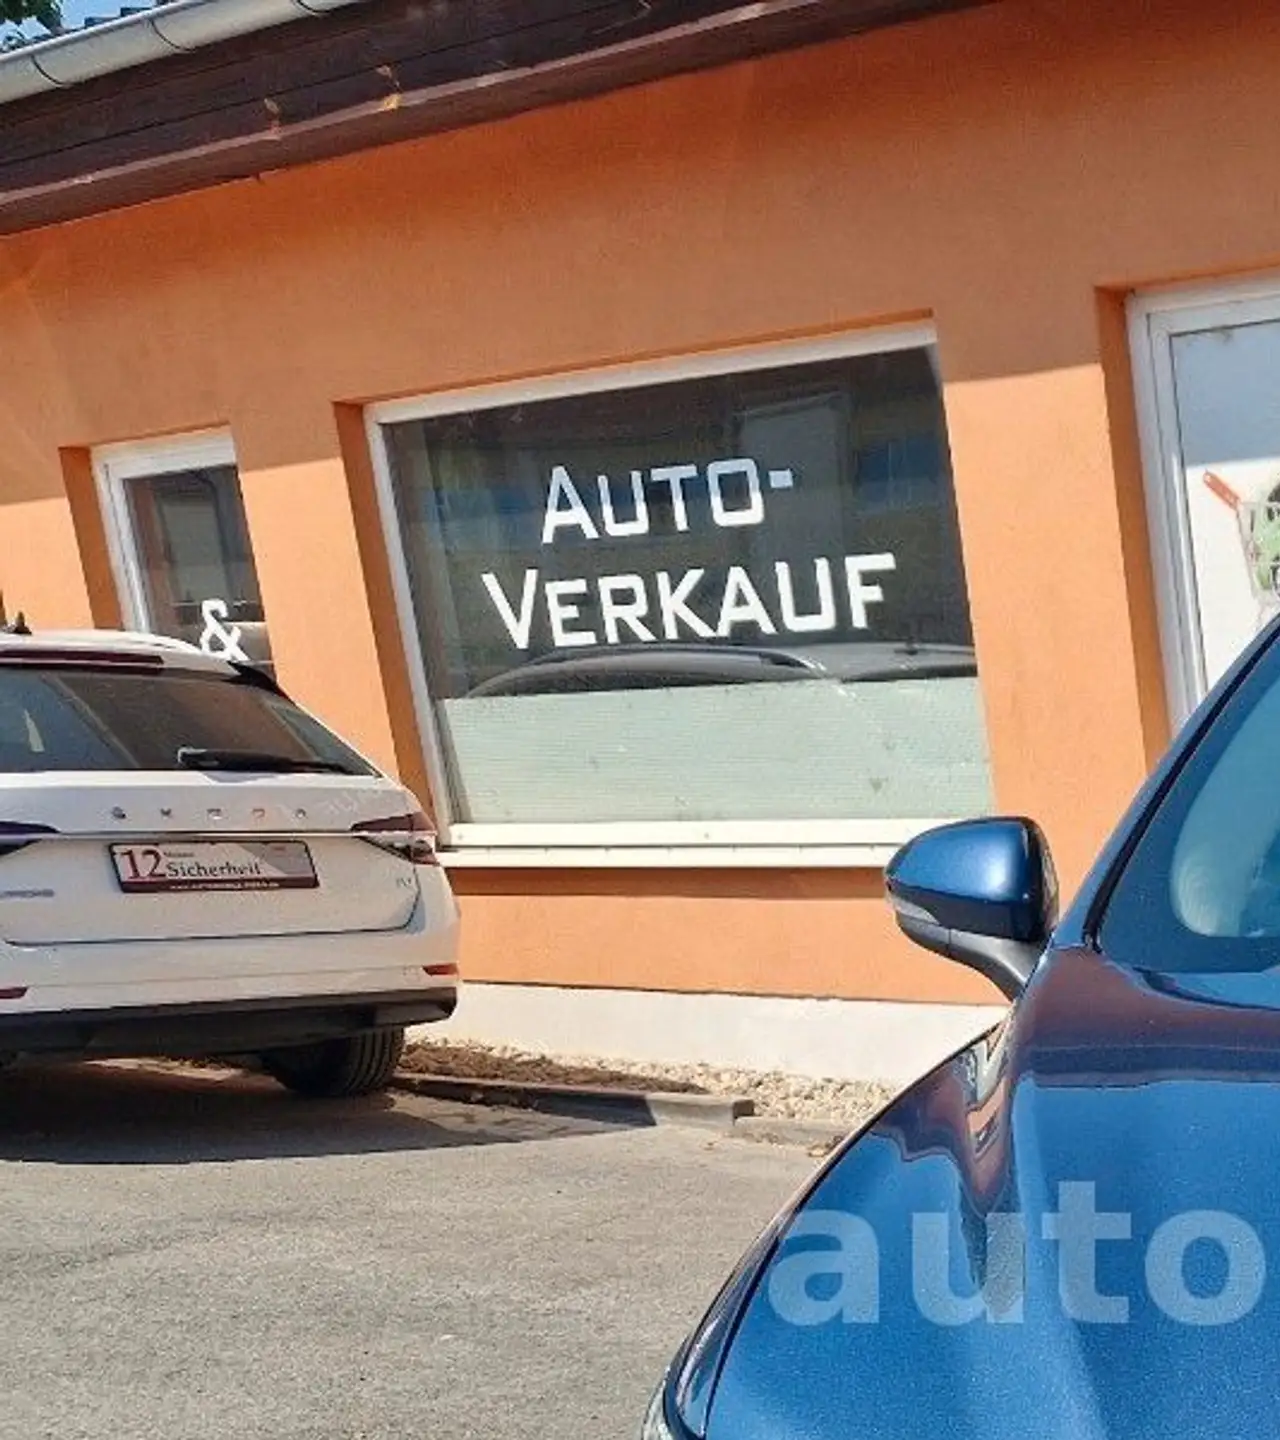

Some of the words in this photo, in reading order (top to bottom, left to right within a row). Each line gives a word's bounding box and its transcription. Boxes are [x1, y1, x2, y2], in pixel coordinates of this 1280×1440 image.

[541, 458, 794, 545] AUTO-
[481, 552, 897, 650] VERKAUF
[121, 849, 166, 879] 12
